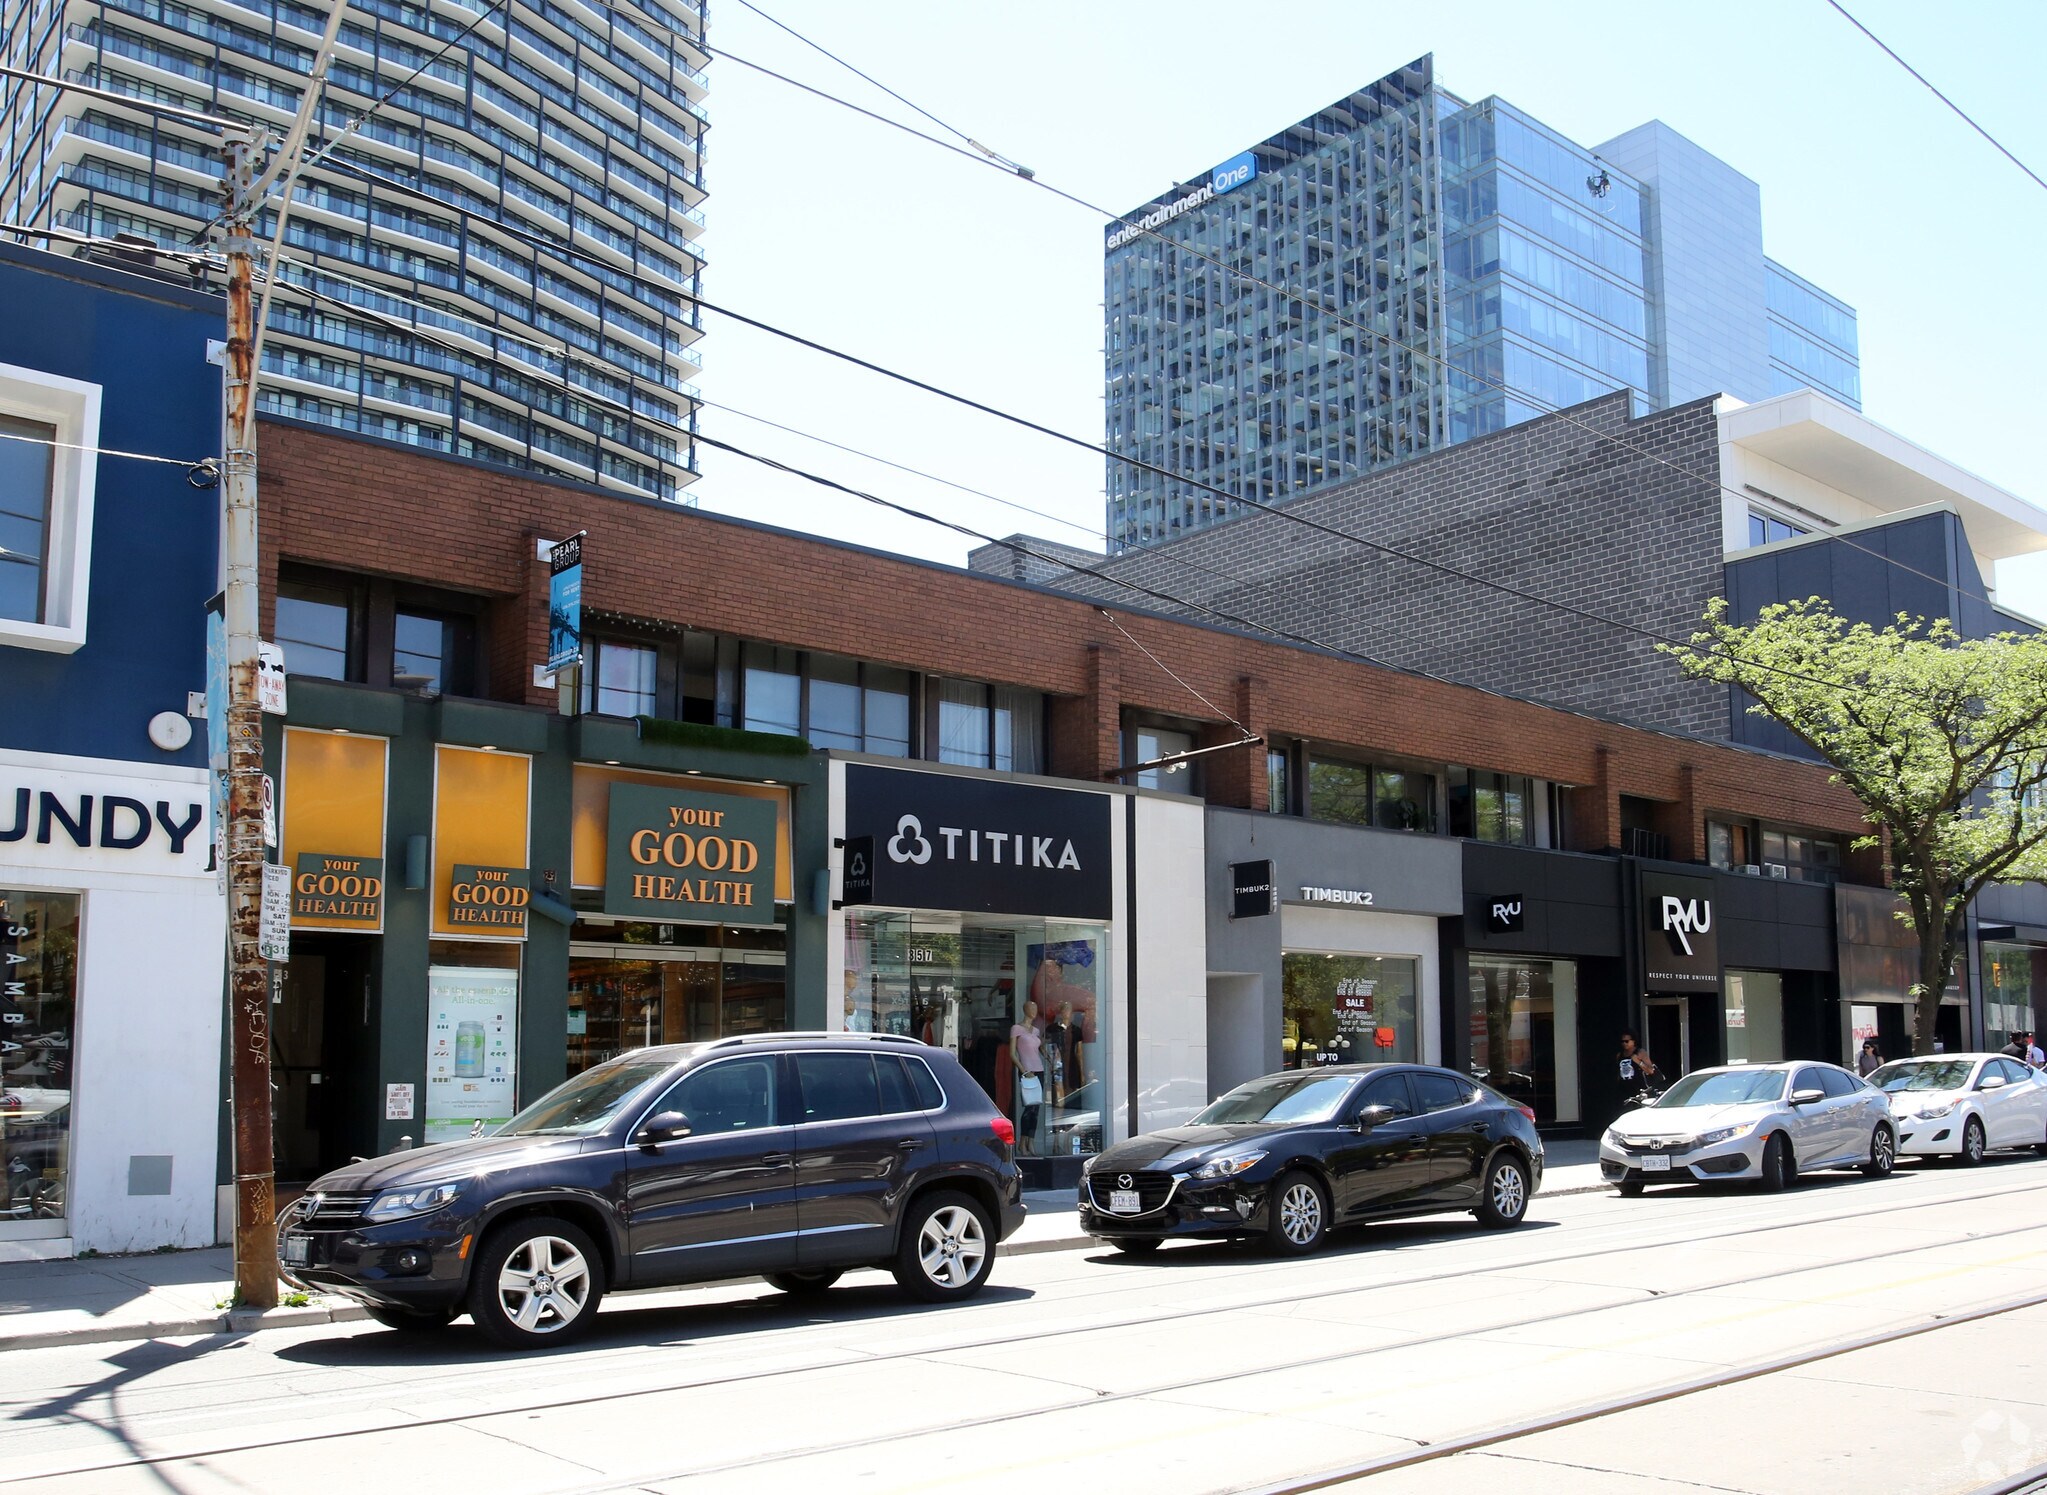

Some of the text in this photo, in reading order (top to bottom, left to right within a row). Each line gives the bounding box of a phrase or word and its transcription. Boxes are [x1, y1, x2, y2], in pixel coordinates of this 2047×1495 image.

[1107, 165, 1249, 249] entertainment One
[555, 539, 580, 559] PEARL
[555, 549, 580, 570] GROUP
[265, 691, 279, 708] ZONE
[669, 805, 724, 829] your
[630, 829, 758, 873] GOOD
[939, 827, 1081, 871] TITIKA
[323, 858, 361, 873] your
[296, 872, 382, 899] GOOD
[476, 869, 509, 884] your
[845, 879, 870, 889] TITIKA
[452, 882, 529, 908] GOOD
[632, 874, 754, 906] HEALTH
[1235, 884, 1270, 894] TIMBUK2
[1301, 886, 1373, 905] TIMBUK2
[297, 898, 376, 917] HEALTH
[453, 907, 524, 926] HEALTH
[1493, 901, 1521, 924] RYU
[1662, 895, 1711, 955] RYU
[908, 948, 933, 962] 857
[1649, 972, 1673, 980] RESPECT
[1, 926, 29, 1052] SAMBA
[1345, 998, 1365, 1007] SALE
[1316, 1053, 1338, 1061] UP TO
